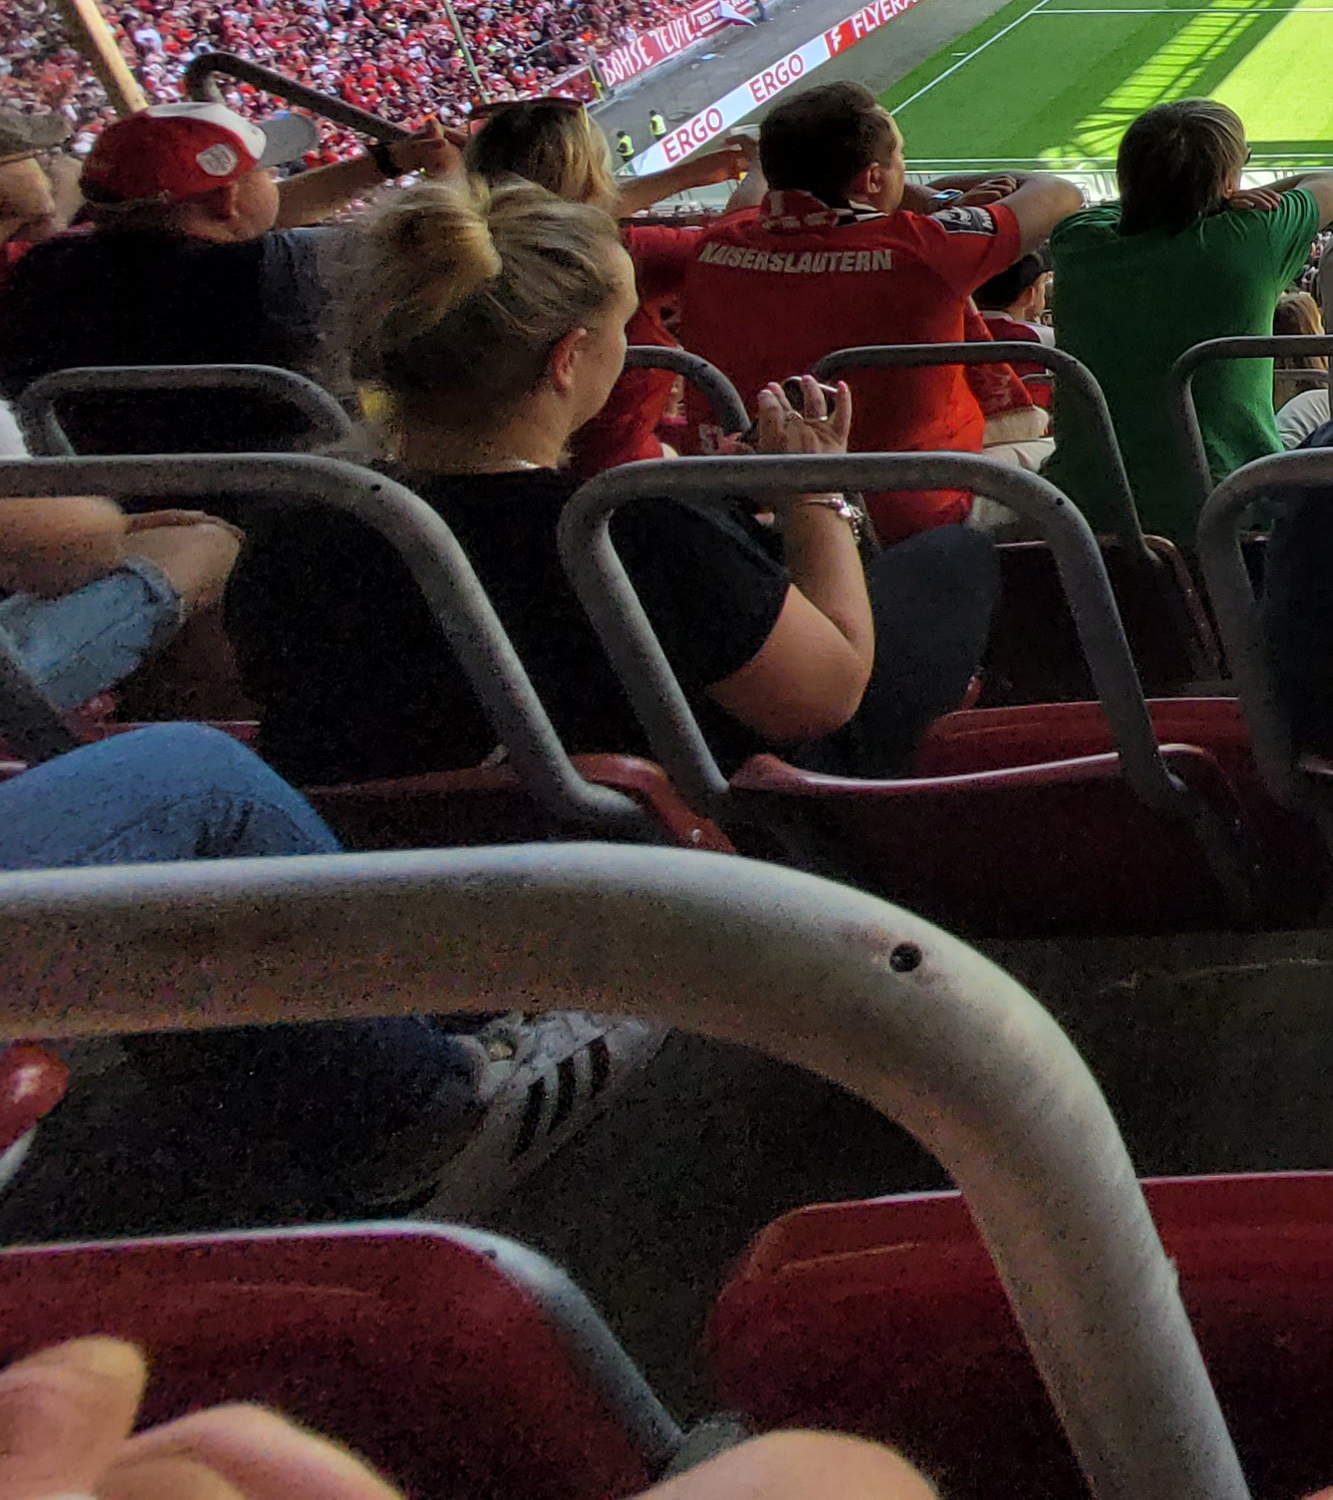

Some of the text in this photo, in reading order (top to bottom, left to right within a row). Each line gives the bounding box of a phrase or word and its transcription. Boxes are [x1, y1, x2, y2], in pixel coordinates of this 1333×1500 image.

[749, 53, 805, 104] ERGO
[661, 107, 724, 164] ERGO
[698, 242, 893, 274] KAISERSLAUTERN
